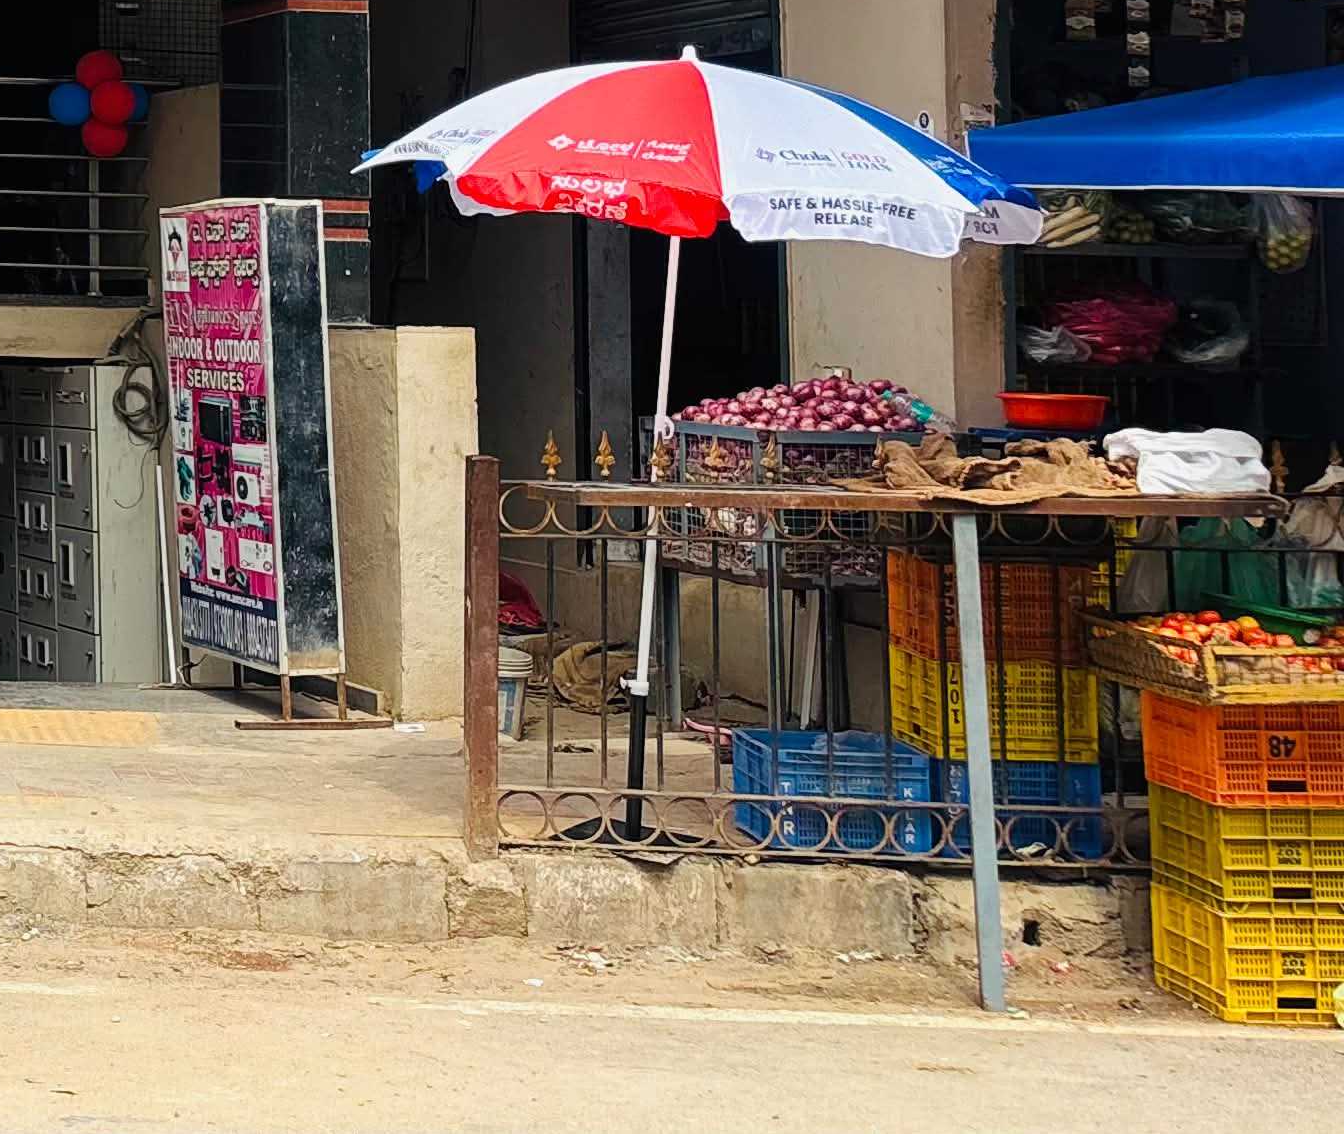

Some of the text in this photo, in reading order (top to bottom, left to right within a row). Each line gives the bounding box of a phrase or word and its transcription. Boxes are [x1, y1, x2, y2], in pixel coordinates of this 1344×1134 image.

[779, 148, 831, 162] Chola
[841, 151, 888, 164] GOLD
[769, 197, 917, 221] SAFE & HASSLE-FREE
[814, 212, 874, 228] RELEASE
[214, 338, 261, 363] OUTDOOR
[186, 368, 245, 392] SERVICES
[1267, 734, 1297, 758] 48
